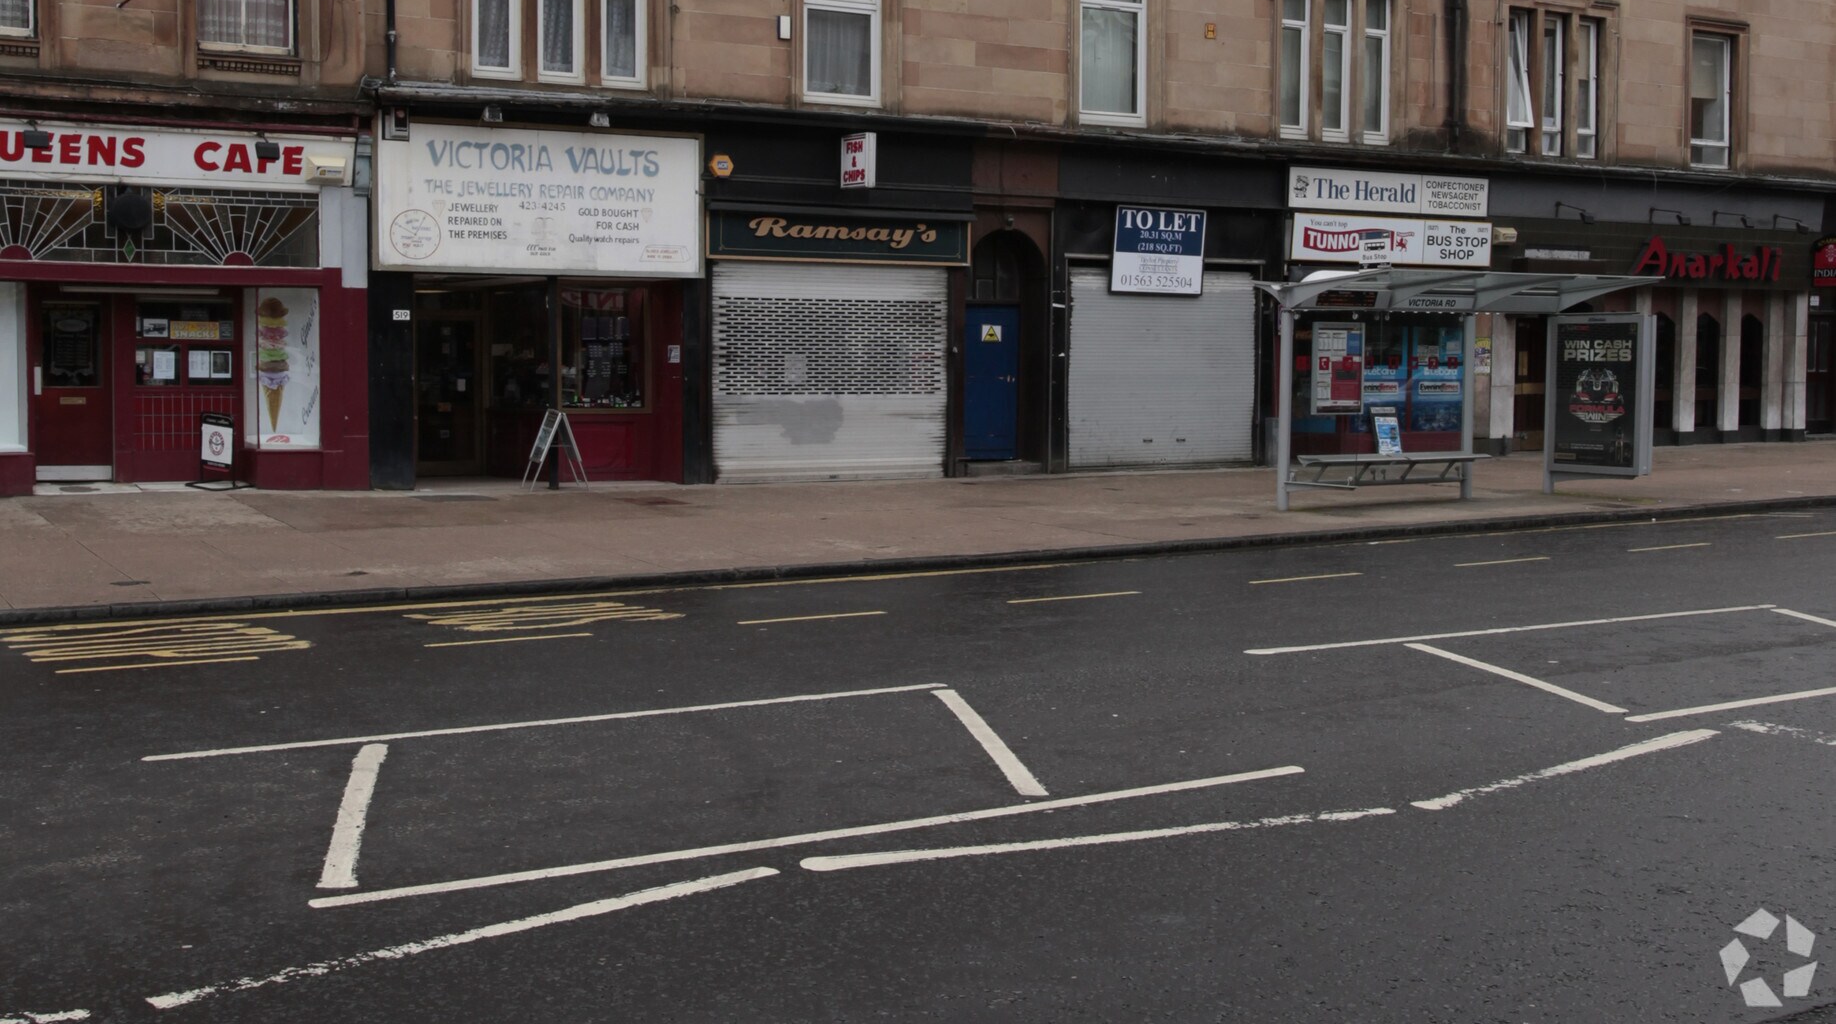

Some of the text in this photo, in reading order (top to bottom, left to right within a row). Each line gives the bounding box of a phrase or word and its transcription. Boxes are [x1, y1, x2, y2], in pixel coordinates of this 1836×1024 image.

[846, 140, 863, 154] FISH
[426, 139, 660, 177] VICTORIA VAULTS
[851, 155, 857, 167] &
[843, 169, 865, 183] CHIPS
[424, 178, 655, 202] THE JEWELLERY REPAIR COMPANY
[1313, 177, 1416, 203] The Herald
[1426, 180, 1485, 191] CONFECTIONER
[1431, 191, 1478, 201] NEWSAGENT
[448, 203, 499, 213] JEWELLERY
[1428, 200, 1482, 211] TOBACCONIST
[578, 207, 639, 218] GOLD BOUGHT
[448, 216, 502, 226] REPAIRED ON
[596, 221, 640, 231] FOR CASH
[1122, 209, 1200, 232] TO LET
[449, 230, 508, 240] THE PREMISES
[748, 216, 937, 250] Ramsay's
[1450, 225, 1466, 234] The
[568, 233, 640, 245] Quality watch repairs
[1140, 230, 1183, 241] 20.31 SQ.M
[1307, 232, 1359, 250] TUNNO
[1427, 236, 1489, 248] BUS STOP
[1138, 242, 1183, 254] (218 SQ.FT)
[1440, 249, 1474, 260] SHOP
[1632, 235, 1783, 282] Anarkali
[1120, 274, 1193, 288] 01563 525504
[1408, 299, 1456, 308] VICTORIA RD
[395, 311, 408, 319] 519
[174, 330, 215, 338] SNACKS
[1564, 339, 1632, 349] WIN CASH
[1563, 349, 1632, 362] PRIZES
[1568, 404, 1625, 414] FORMULA
[1585, 413, 1606, 421] WIN
